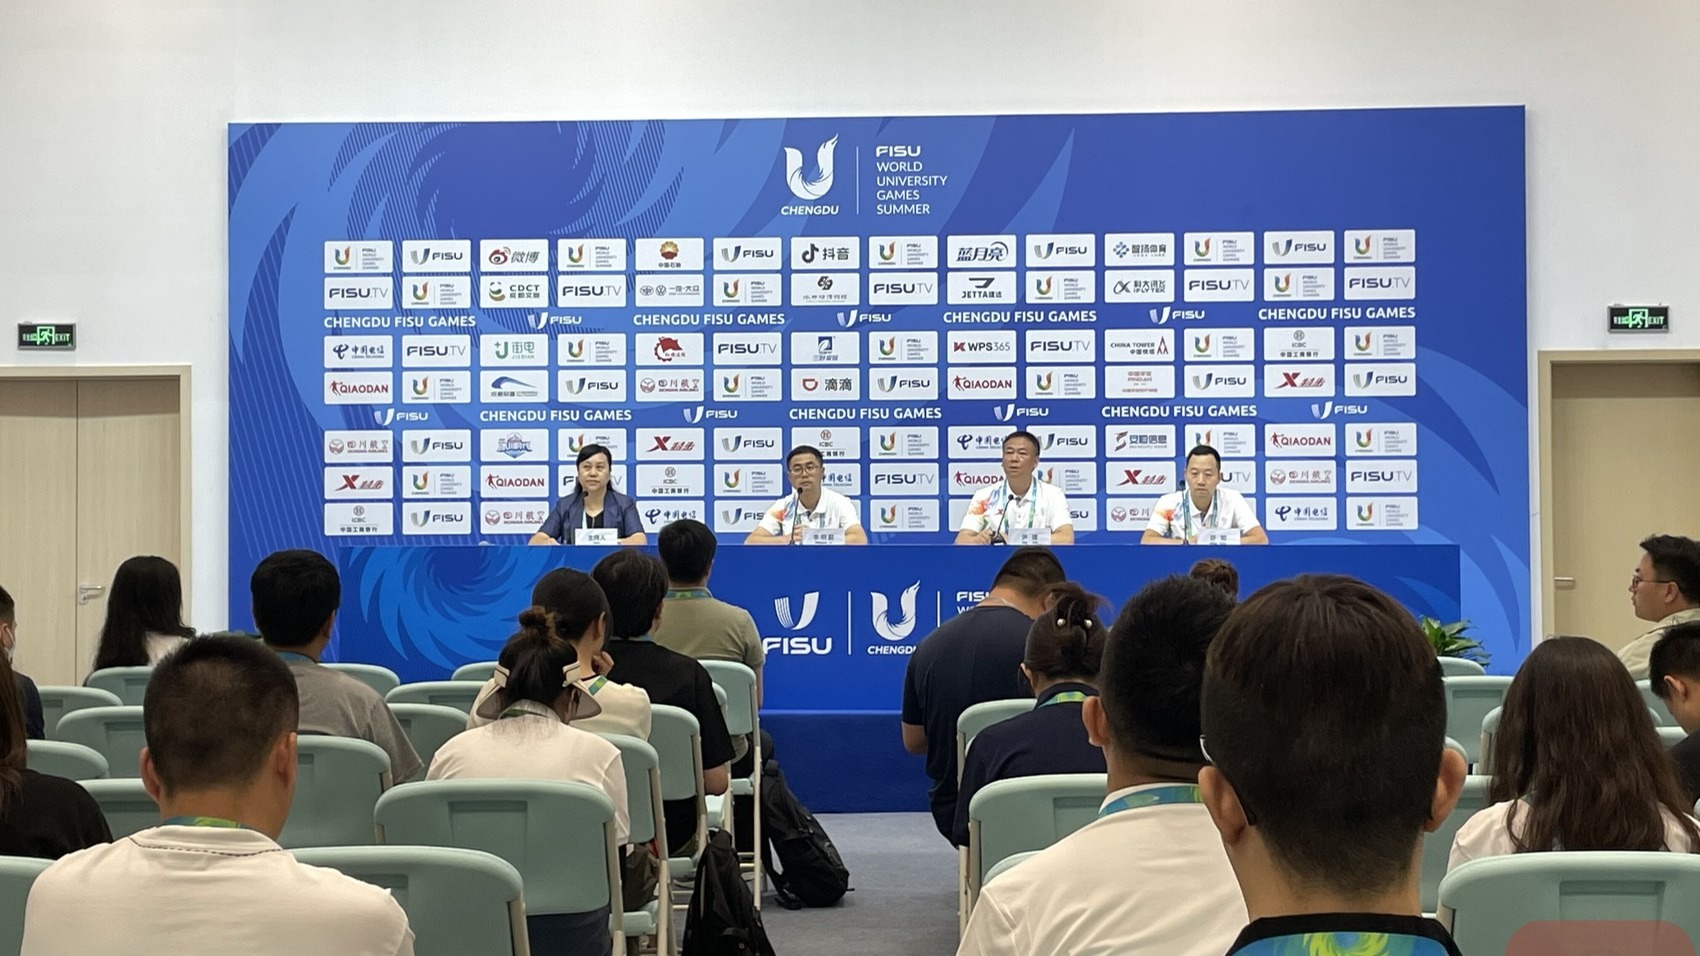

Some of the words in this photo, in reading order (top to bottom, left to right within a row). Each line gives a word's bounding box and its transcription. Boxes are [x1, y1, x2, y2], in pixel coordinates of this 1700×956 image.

[875, 146, 921, 157] FISU
[877, 162, 922, 172] WORLD
[877, 176, 947, 186] UNIVERSITY
[877, 190, 920, 200] GAMES
[781, 206, 839, 215] CHENGDU
[877, 204, 930, 215] SUMMER
[1056, 246, 1087, 254] FISU
[1295, 243, 1326, 251] FISU
[432, 252, 463, 260] FISU
[511, 251, 540, 263] 微博
[743, 250, 774, 258] FISU
[822, 247, 849, 260] 抖音
[956, 247, 1005, 262] 蓝月亮
[1189, 280, 1249, 290] FISU.TV
[1349, 278, 1410, 289] FISU.TV
[329, 288, 389, 298] FISU.TV
[562, 286, 621, 296] FISU.TV
[873, 283, 933, 294] FISU.TV
[860, 313, 891, 322] FISU
[943, 312, 1011, 323] CHENGDU
[1014, 311, 1044, 322] FISU
[1048, 310, 1097, 322] GAMES
[1172, 311, 1205, 319] FISU
[1258, 308, 1327, 319] CHENGDU
[1331, 308, 1361, 319] FISU
[1366, 307, 1415, 318] GAMES
[324, 317, 392, 328] CHENGDU
[395, 317, 425, 327] FISU
[428, 316, 476, 327] GAMES
[550, 316, 582, 324] FISU
[633, 314, 700, 325] CHENGDU
[704, 314, 733, 325] FISU
[737, 314, 785, 324] GAMES
[1649, 316, 1664, 324] EXIT
[55, 333, 70, 341] EXIT
[352, 345, 384, 354] 中国电信
[407, 345, 466, 356] FISU.TV
[718, 344, 777, 354] FISU.TV
[968, 342, 1010, 351] WPS365
[1031, 341, 1090, 351] FISU.TV
[658, 379, 699, 388] 四川航空
[899, 379, 930, 388] FISU
[1215, 377, 1246, 385] FISU
[1376, 375, 1407, 383] FISU
[340, 384, 388, 393] QIAODAN
[588, 382, 618, 390] FISU
[825, 378, 852, 391] 滴滴
[963, 380, 1012, 389] QIAODAN
[706, 410, 738, 418] FISU
[789, 408, 856, 419] CHENGDU
[860, 408, 889, 419] FISU
[894, 408, 941, 419] GAMES
[1016, 407, 1049, 416] FISU
[1101, 406, 1170, 418] CHENGDU
[1174, 406, 1204, 417] FISU
[1208, 405, 1257, 416] GAMES
[1335, 405, 1368, 414] FISU
[396, 412, 428, 420] FISU
[480, 410, 546, 421] CHENGDU
[551, 410, 580, 420] FISU
[584, 409, 632, 420] GAMES
[347, 440, 388, 449] 四川航空
[432, 441, 463, 449] FISU
[743, 440, 775, 448] FISU
[1057, 437, 1088, 446] FISU
[1281, 437, 1331, 446] QIAODAN
[875, 473, 935, 484] FISU.TV
[965, 474, 1004, 484] QIAODA
[1289, 470, 1332, 479] 四川航空
[1351, 471, 1412, 482] FISU.TV
[496, 478, 544, 487] QIAODAN
[664, 510, 696, 519] 中国电信
[1294, 506, 1328, 516] 中国电信
[433, 514, 463, 522] FISU
[744, 512, 764, 520] FIS
[762, 637, 832, 655] FISU
